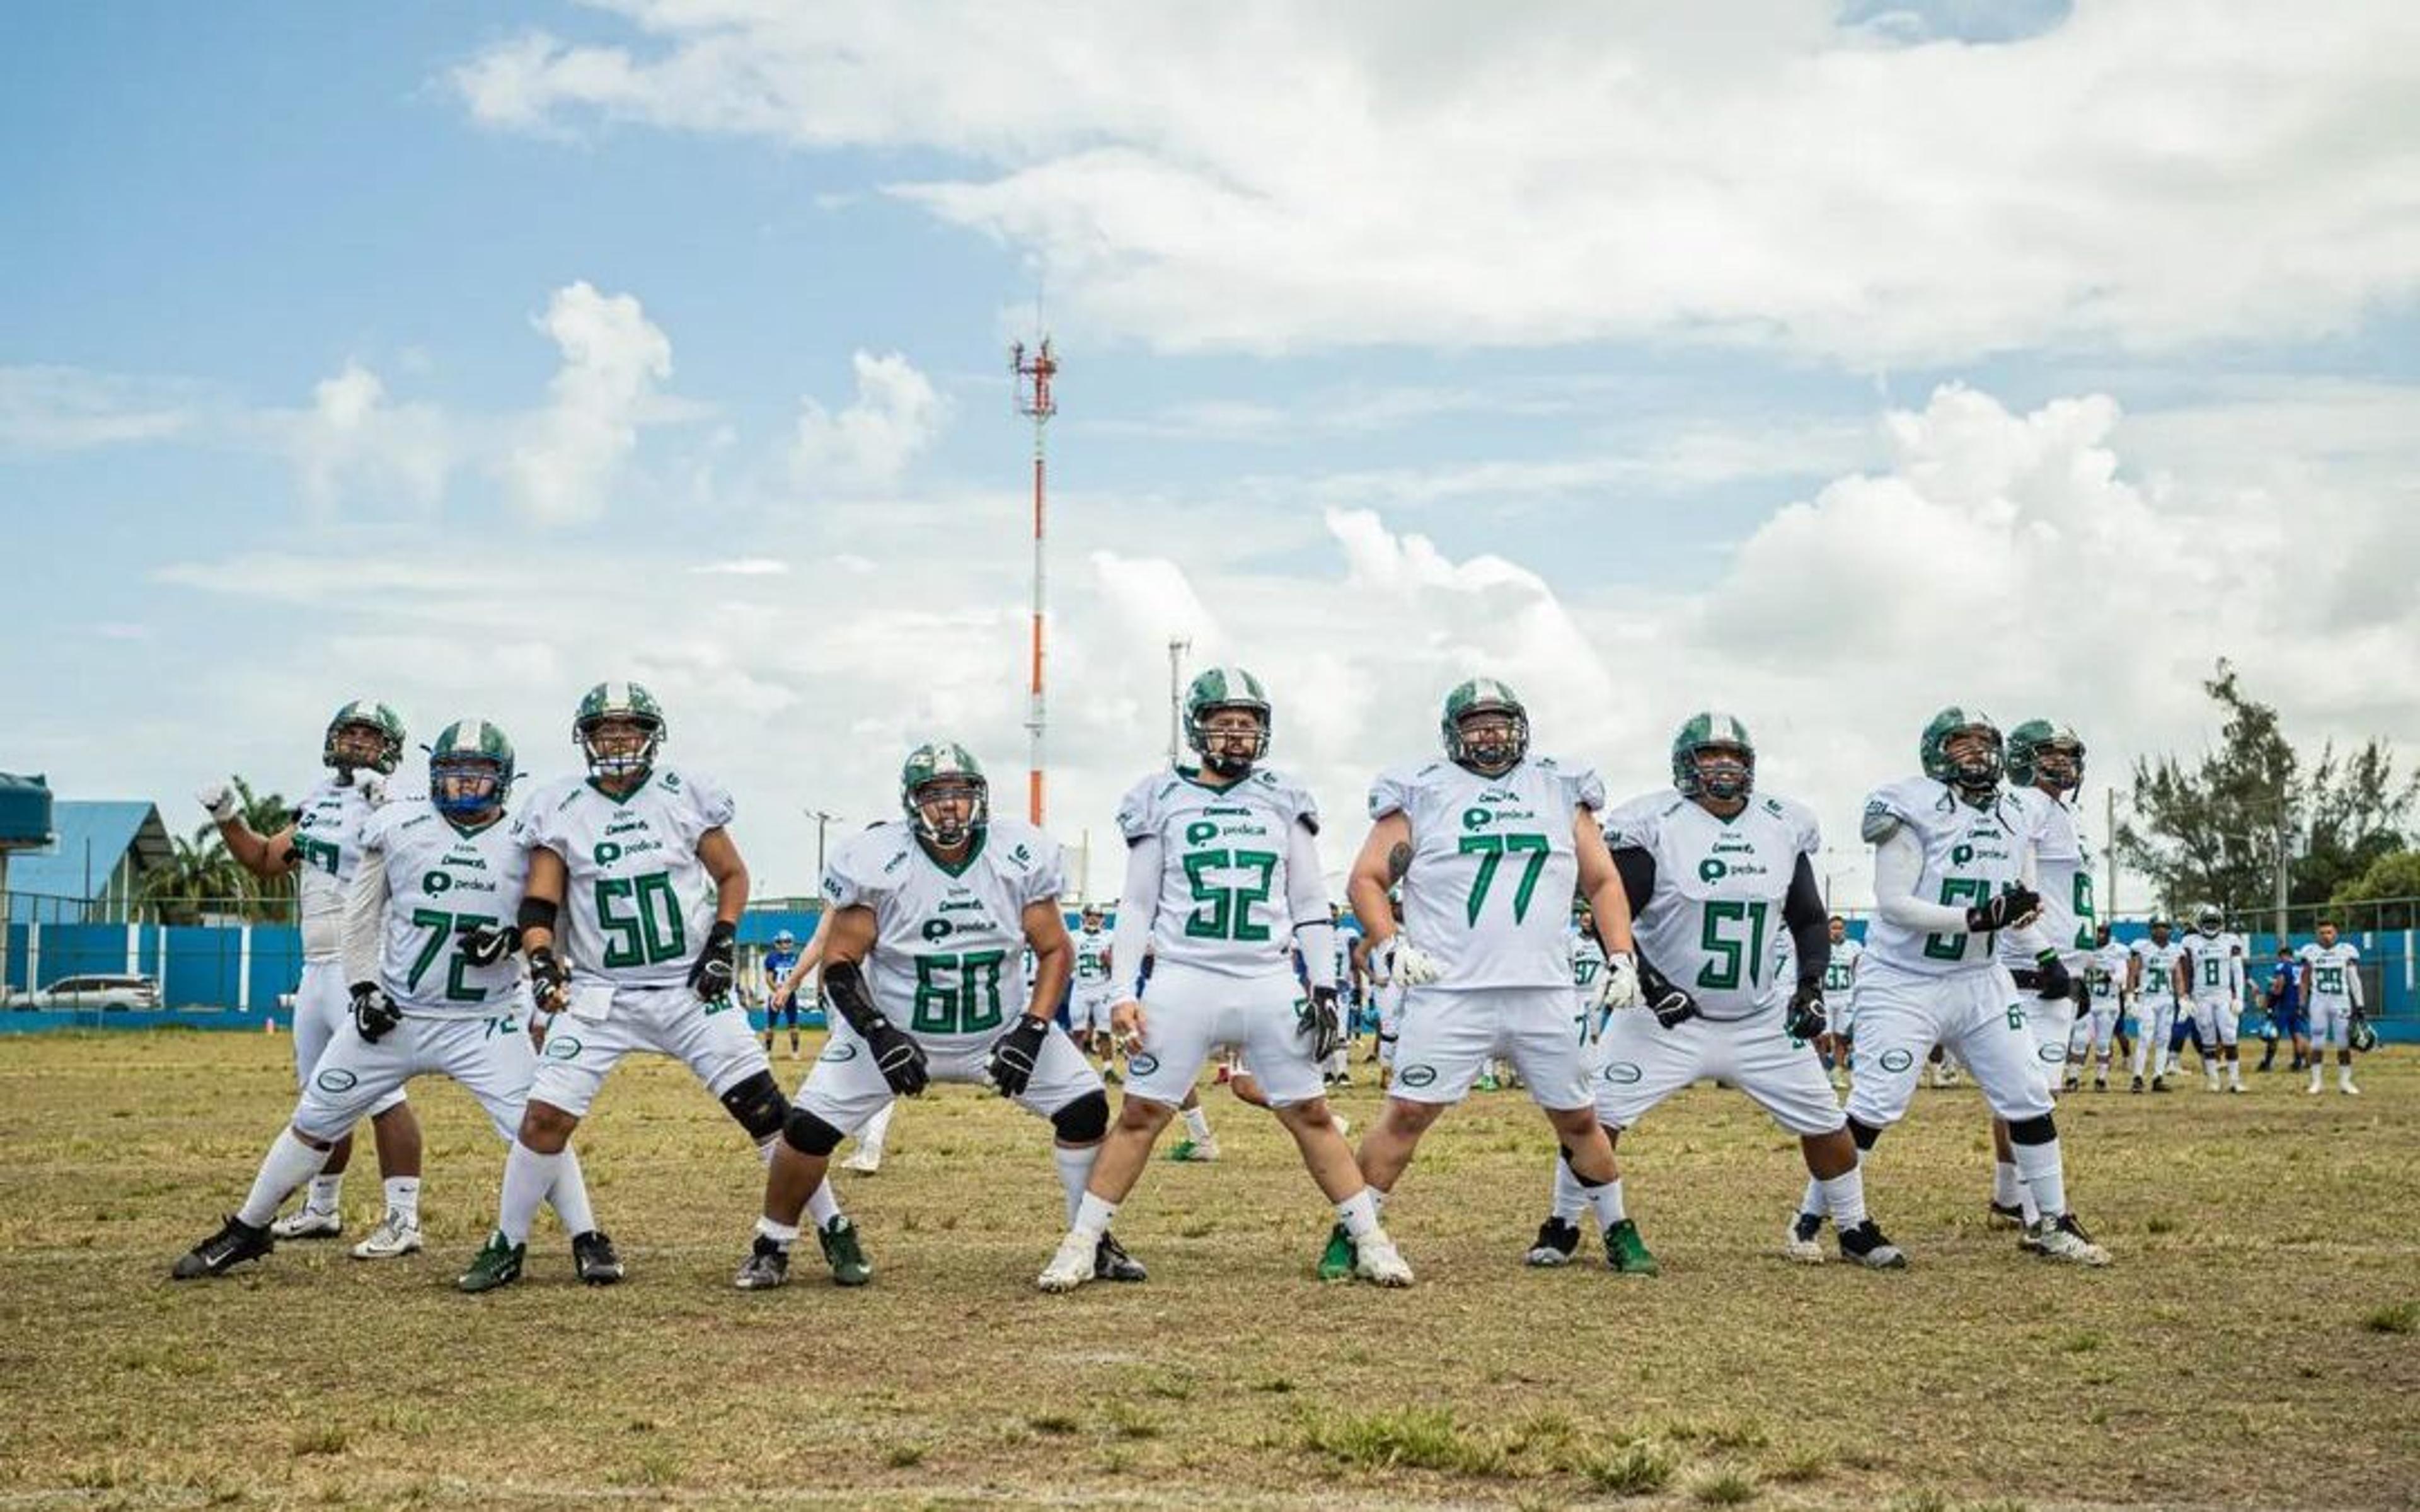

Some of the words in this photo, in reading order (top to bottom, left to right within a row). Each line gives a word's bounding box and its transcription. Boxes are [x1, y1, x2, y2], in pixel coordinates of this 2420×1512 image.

[596, 871, 686, 968] 50
[1183, 849, 1277, 941] 52
[1459, 833, 1550, 929] 77
[408, 908, 498, 1001] 72
[1697, 900, 1768, 990] 51
[2206, 958, 2219, 985] 8
[912, 949, 1006, 1034] 60
